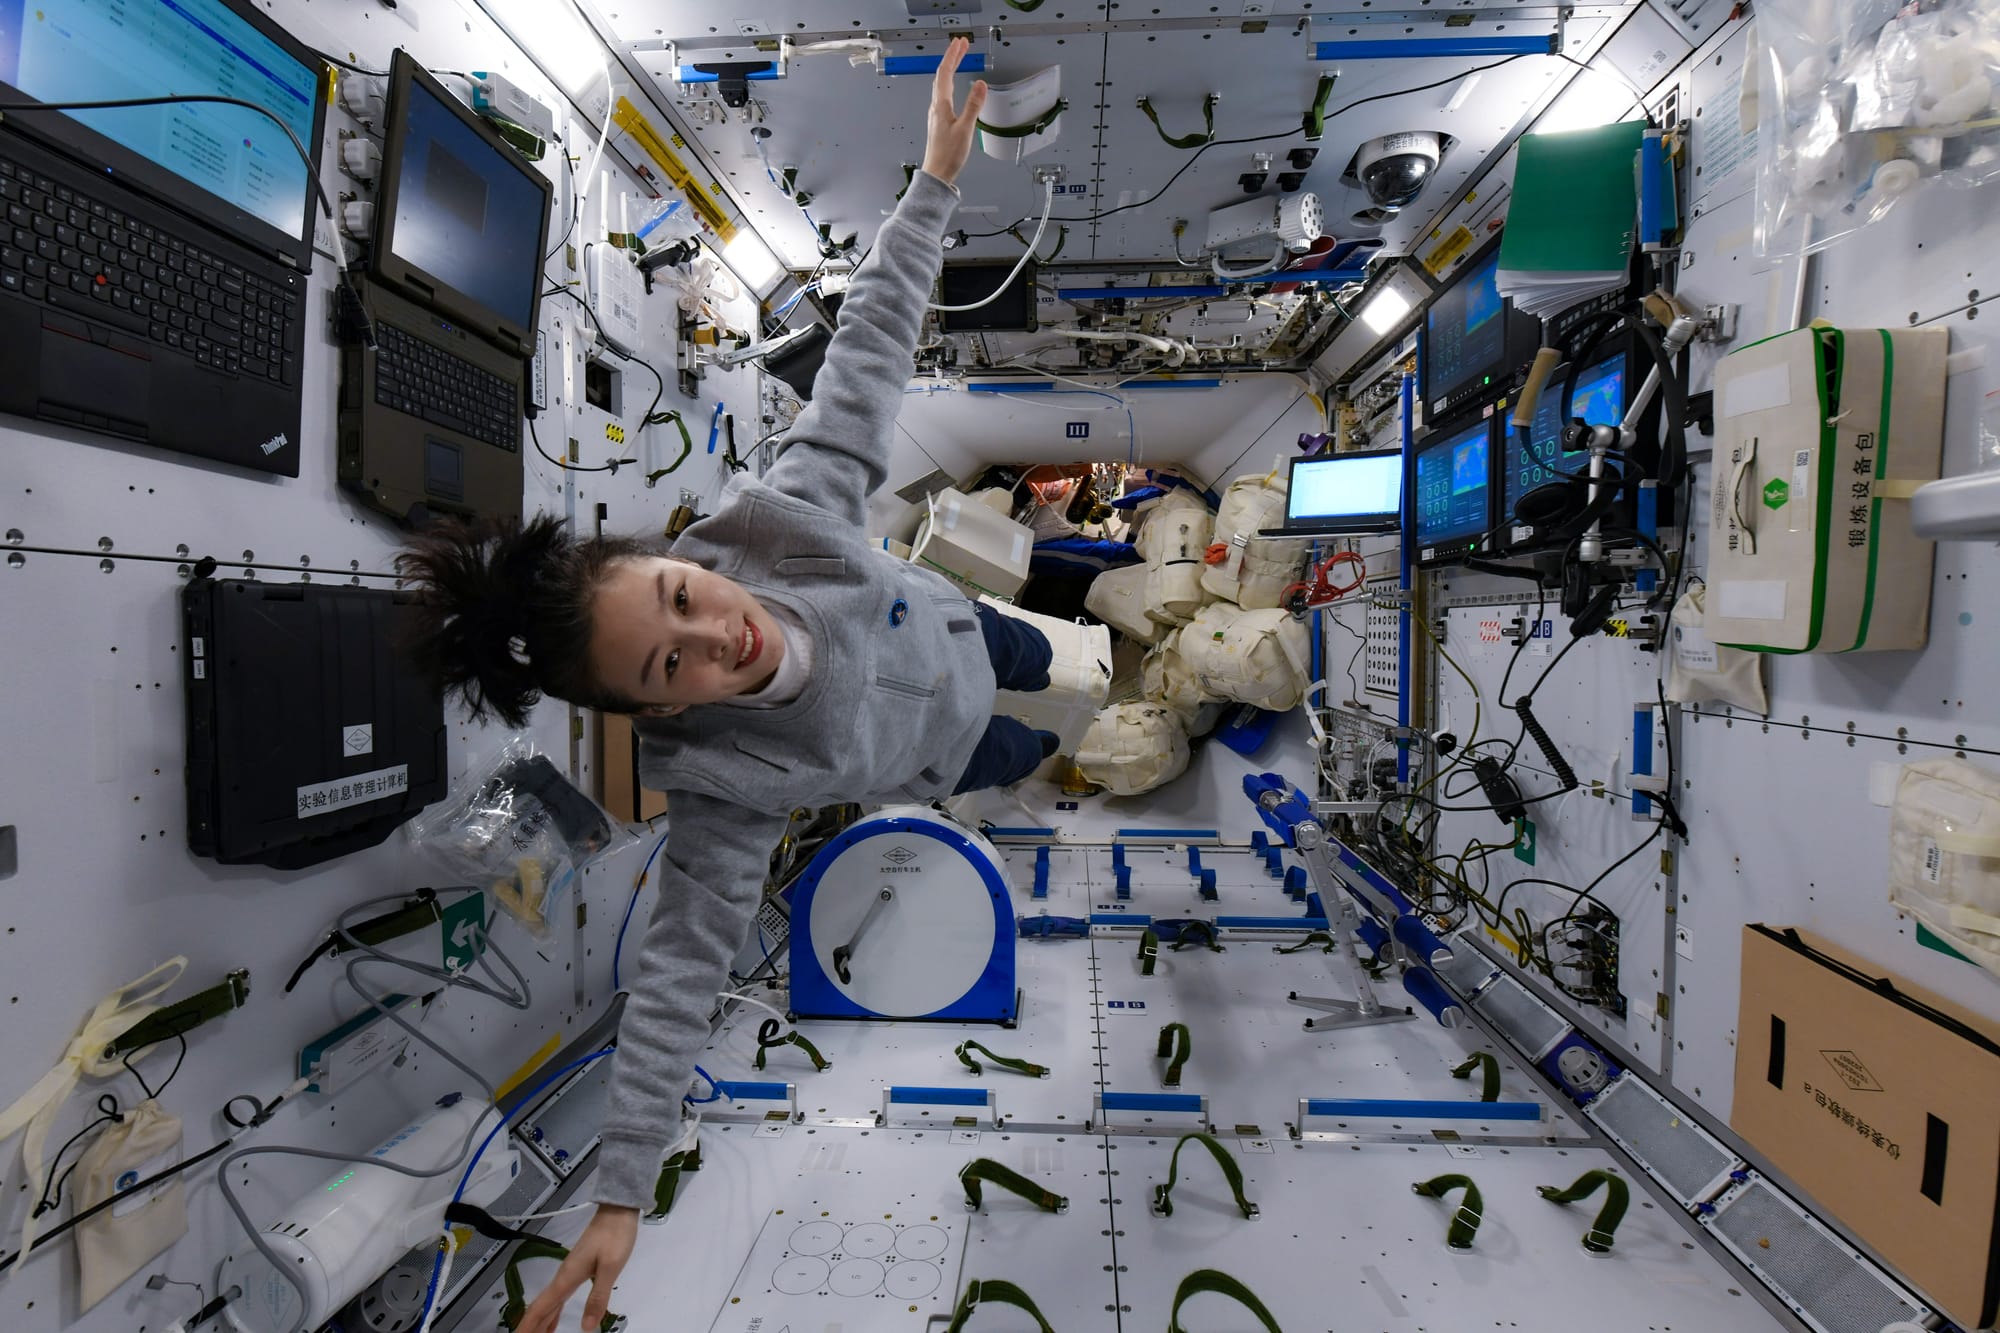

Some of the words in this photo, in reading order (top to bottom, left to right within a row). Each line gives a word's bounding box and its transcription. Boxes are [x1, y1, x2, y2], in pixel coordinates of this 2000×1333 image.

[260, 432, 288, 456] ThinkPad
[1848, 432, 1875, 548] 锻炼设备包
[298, 772, 408, 812] 实验信息管理计算机
[1815, 1088, 1900, 1160] 仪表终端软包
